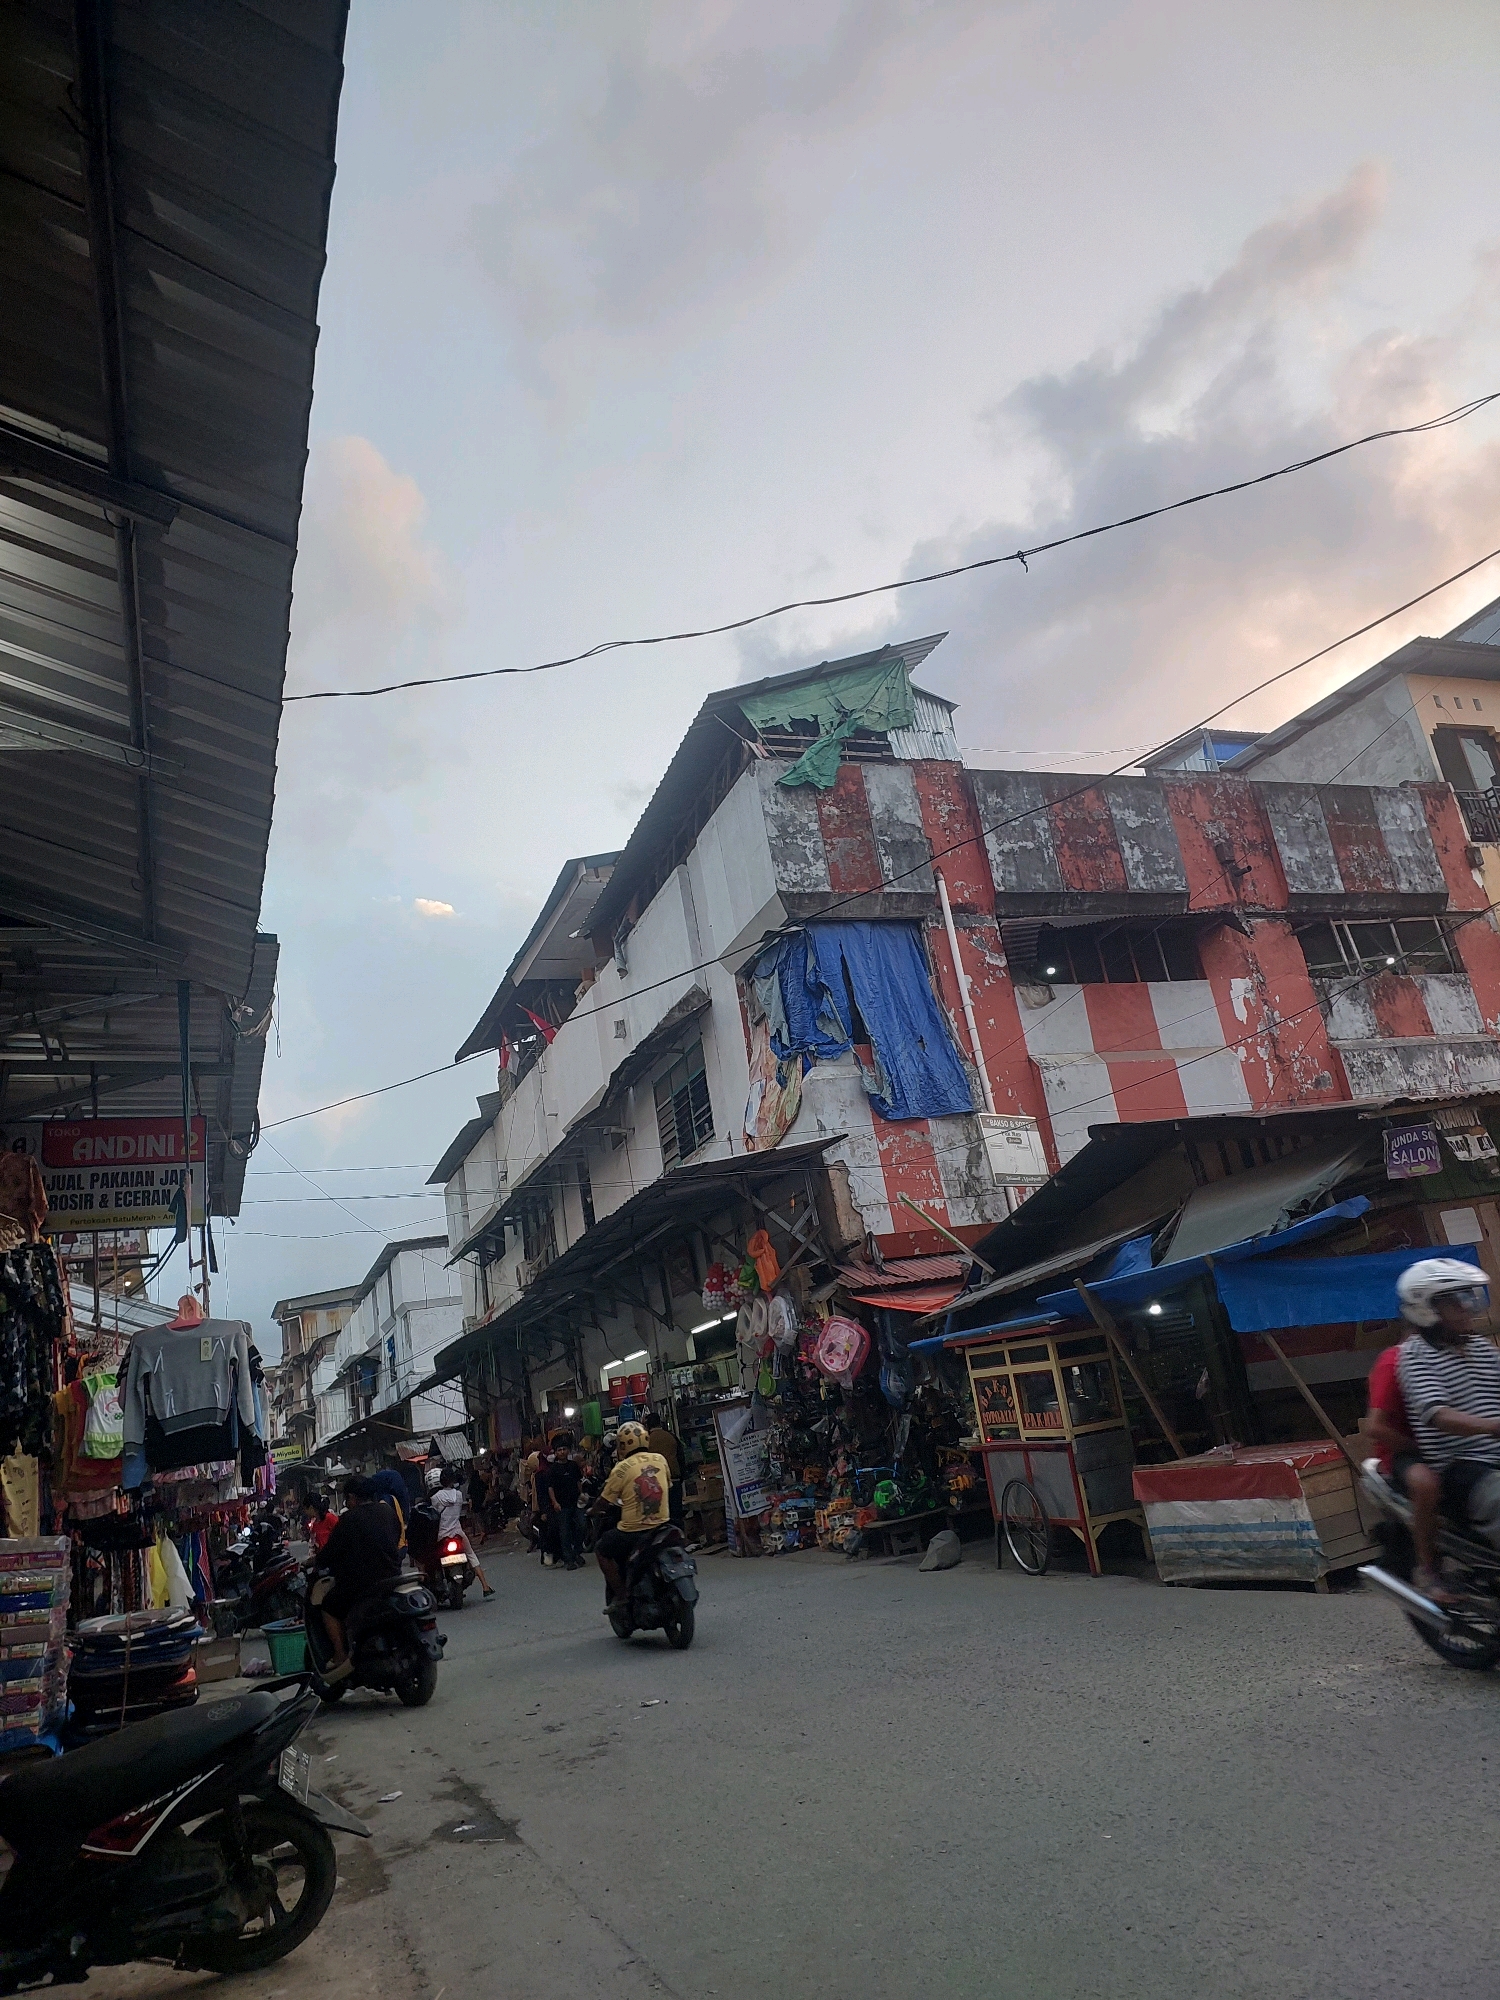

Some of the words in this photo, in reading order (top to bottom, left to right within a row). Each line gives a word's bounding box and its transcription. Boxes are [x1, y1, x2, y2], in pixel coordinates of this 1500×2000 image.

[49, 1126, 81, 1137] TOKO
[72, 1134, 175, 1161] ANDINI
[180, 1131, 199, 1156] 2
[1393, 1146, 1436, 1165] SALON
[90, 1170, 154, 1190] PAKAIAN
[48, 1193, 94, 1211] ROSIR
[99, 1193, 109, 1209] &
[115, 1189, 170, 1208] ECERAN
[70, 1217, 111, 1226] Pertokoan
[276, 1449, 300, 1458] Miyako
